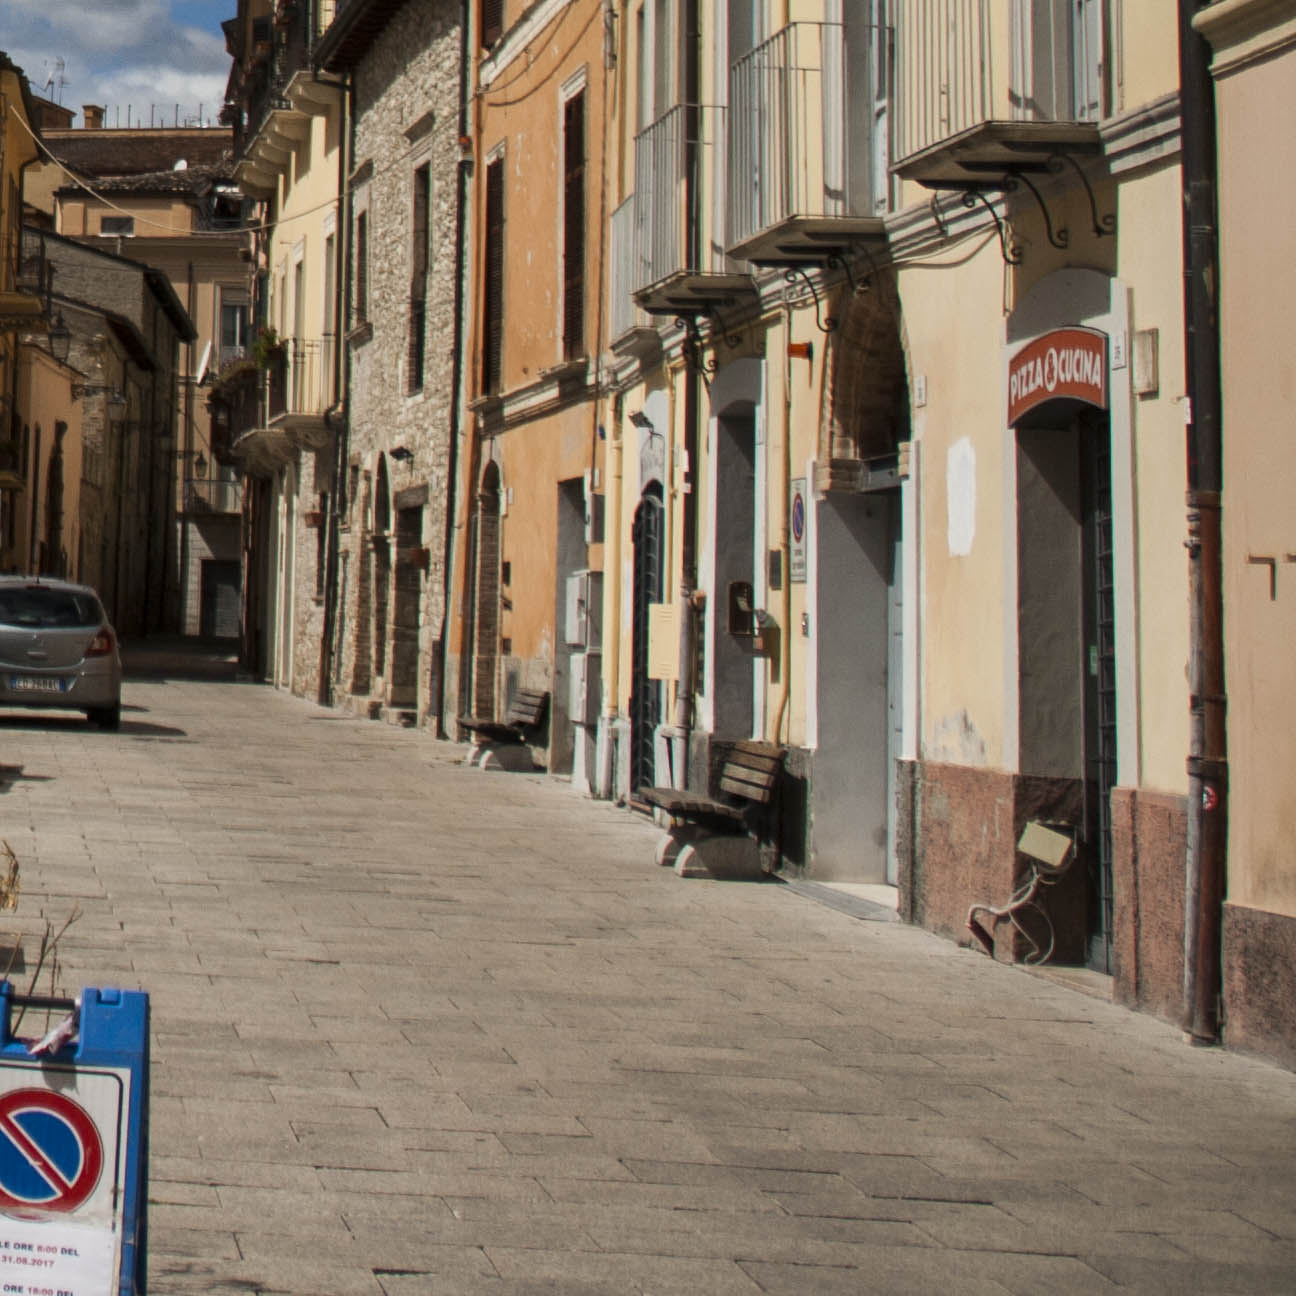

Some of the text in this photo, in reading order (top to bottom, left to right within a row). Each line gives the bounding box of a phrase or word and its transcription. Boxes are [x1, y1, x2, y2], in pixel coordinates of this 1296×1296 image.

[1010, 357, 1044, 406] PIZZA
[1059, 348, 1101, 389] CUCINA
[13, 1242, 33, 1251] ORE
[60, 1247, 79, 1257] DEL
[1, 1254, 55, 1268] 31.08.2017
[3, 1283, 24, 1294] ORE
